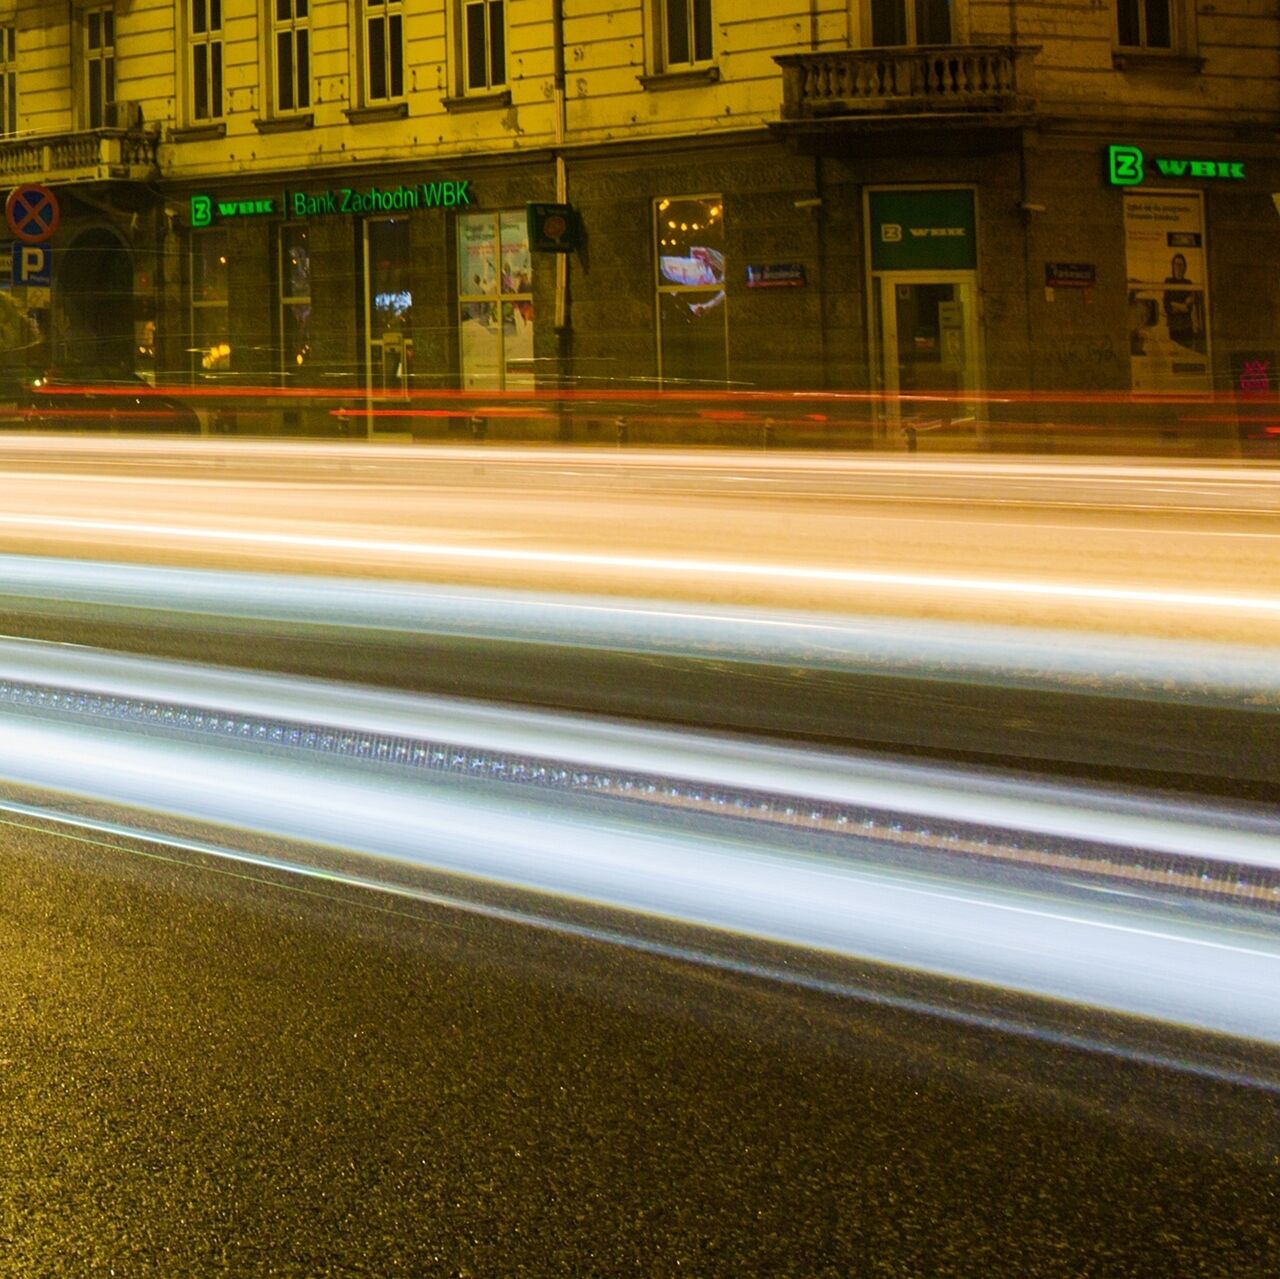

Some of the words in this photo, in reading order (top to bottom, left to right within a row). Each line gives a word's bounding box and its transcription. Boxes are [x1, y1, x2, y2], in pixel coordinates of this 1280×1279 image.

[1156, 159, 1245, 178] WBK
[218, 199, 273, 216] WBK
[294, 192, 336, 216] Bank
[340, 187, 419, 213] Zachodni
[423, 181, 470, 207] WBK
[910, 227, 966, 237] WBK
[21, 247, 44, 281] P
